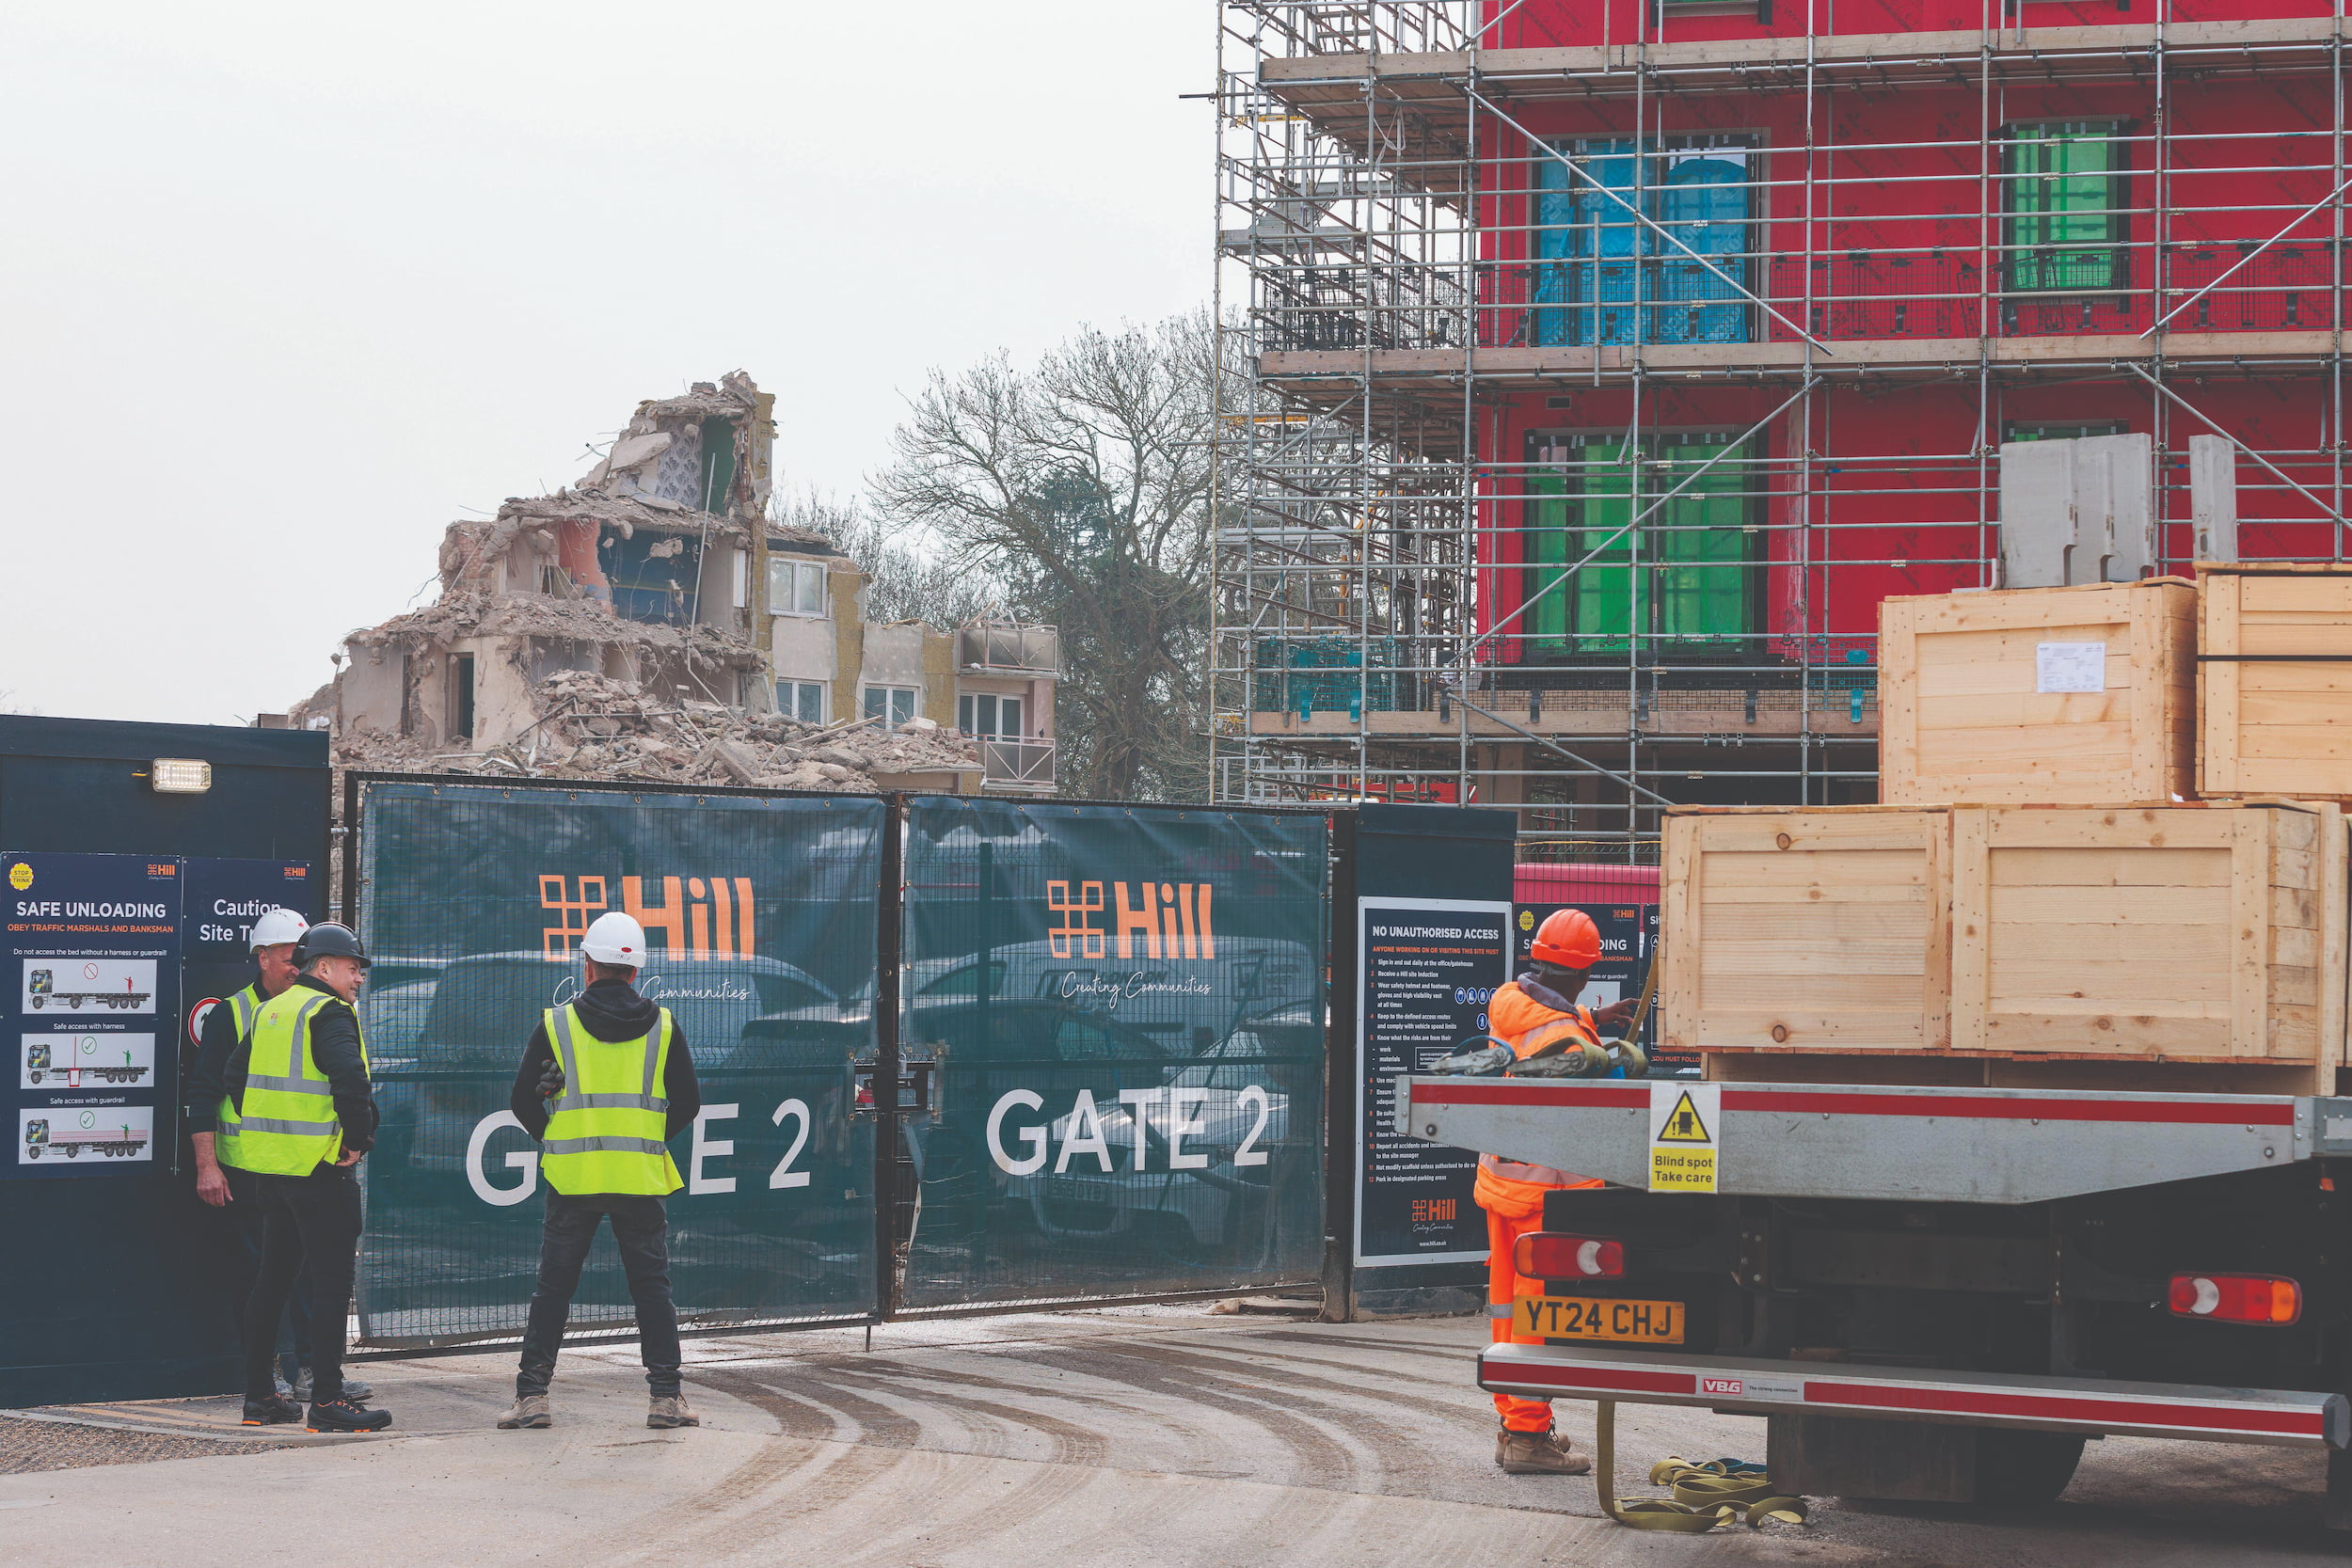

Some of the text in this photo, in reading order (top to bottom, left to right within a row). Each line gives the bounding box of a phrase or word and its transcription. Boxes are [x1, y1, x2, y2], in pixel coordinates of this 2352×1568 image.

[158, 865, 175, 875] Hill
[292, 868, 305, 877] Hill
[17, 902, 166, 918] SAFE UNLOADING
[622, 876, 754, 961] Hill
[1621, 910, 1634, 918] Hill
[1114, 881, 1215, 959] Hill
[200, 924, 233, 941] Site
[1373, 926, 1499, 939] NO UNAUTHORISED ACCESS
[640, 975, 750, 1001] Communities
[1061, 971, 1212, 1009] Creating Communities
[986, 1085, 1269, 1176] GATE 2
[467, 1098, 810, 1205] GE 2
[1655, 1156, 1712, 1169] Blind spot
[1655, 1172, 1712, 1183] Take care
[1429, 1199, 1456, 1220] Hill
[1526, 1301, 1671, 1336] YT24 CHJ
[1705, 1380, 1740, 1392] VBG
